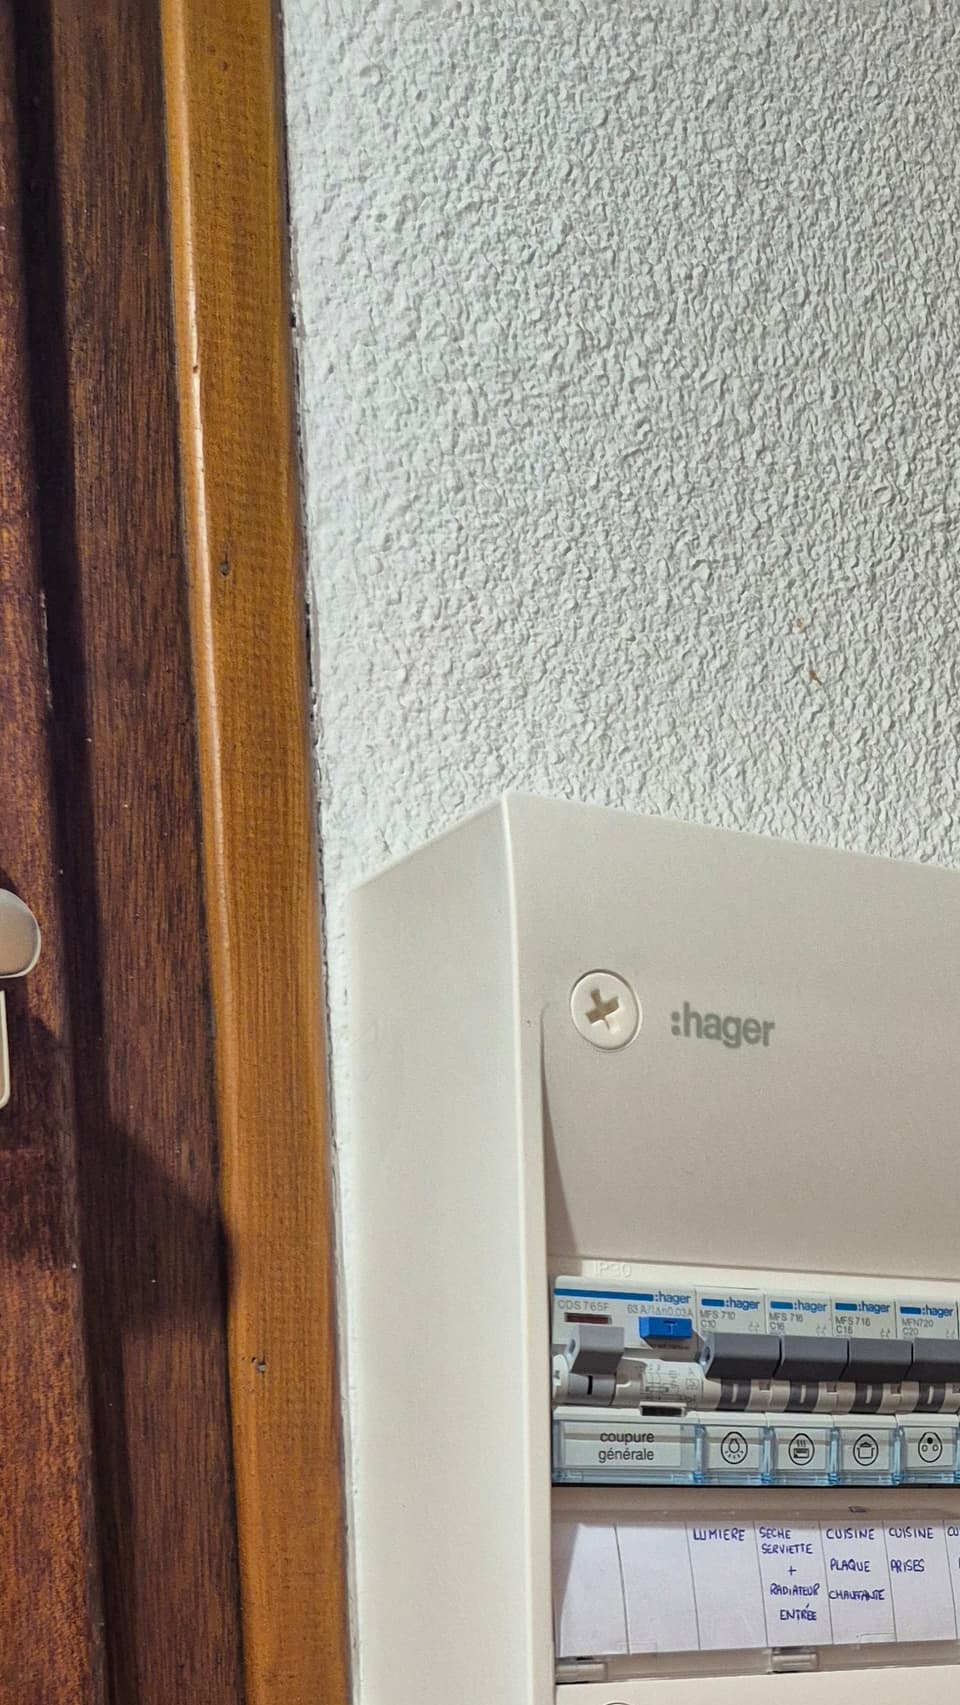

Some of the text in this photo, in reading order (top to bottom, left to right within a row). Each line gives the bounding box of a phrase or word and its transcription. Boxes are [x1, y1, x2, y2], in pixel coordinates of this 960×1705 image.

[600, 1431, 655, 1445] coupure
[598, 1447, 655, 1464] générale
[692, 1528, 746, 1542] LUMIERE
[759, 1526, 792, 1540] SECHE
[826, 1527, 876, 1541] CUISINE
[888, 1525, 935, 1540] CUISINE
[761, 1543, 814, 1555] SERVIETTE
[830, 1557, 872, 1573] PLAQUE
[890, 1558, 926, 1574] PRISES
